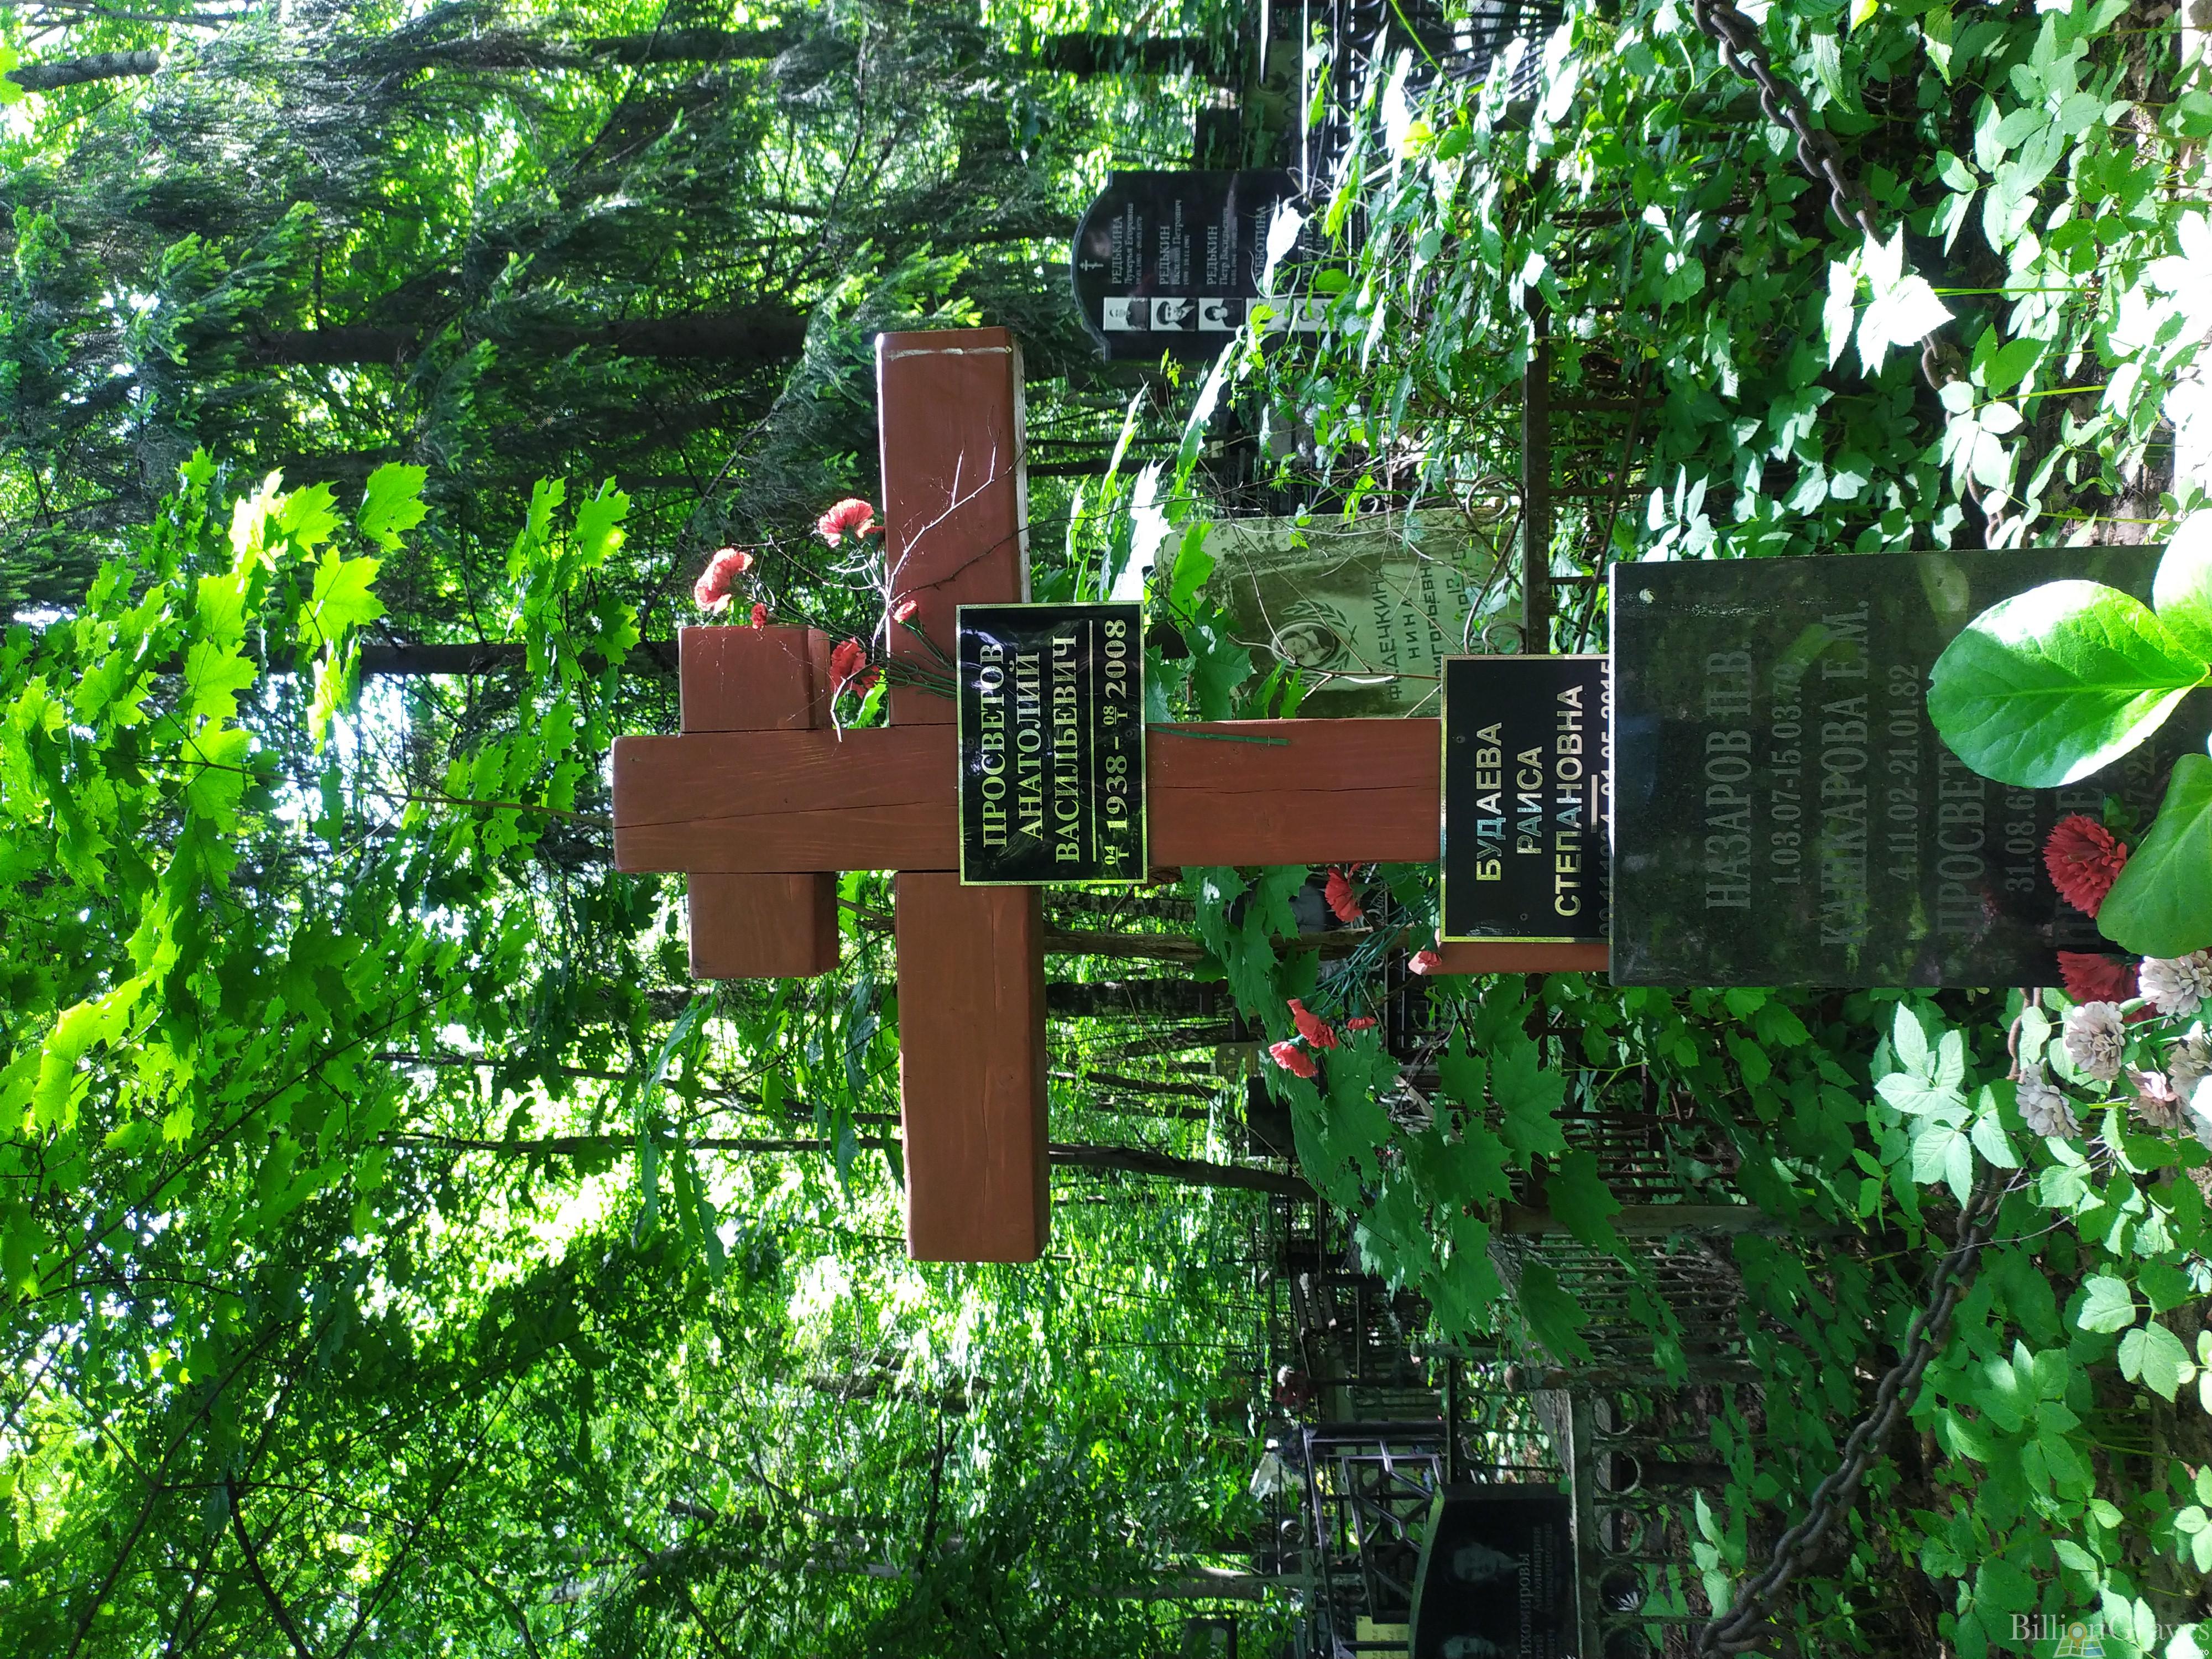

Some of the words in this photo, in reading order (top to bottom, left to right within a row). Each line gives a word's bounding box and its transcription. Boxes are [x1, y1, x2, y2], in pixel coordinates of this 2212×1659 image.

[1112, 216, 1123, 284] РЕДЬКИНА
[1159, 225, 1170, 285] РЕДЬКИН
[1172, 199, 1184, 244] Петрович
[1207, 225, 1218, 285] РЕДЬКИН
[1219, 262, 1230, 285] Петр
[1254, 205, 1266, 278] УББОТИНА
[1104, 619, 1127, 698] 2008
[1401, 597, 1421, 660] НИНА
[1419, 563, 1444, 694] ИГОРЬЕВН
[1820, 601, 1869, 680] Е.М.
[979, 644, 1008, 848] ПРОСВЕТОВ
[1009, 652, 1044, 841] АНАТОЛИЙ
[1052, 634, 1080, 863] ВАСИЛЬЕВИЧ
[1105, 755, 1128, 832] 1938
[1516, 746, 1543, 854] РАИСА
[1887, 664, 1920, 881] 4.11.02-21.01.82
[1475, 722, 1506, 881] БУДАЕВА
[1554, 685, 1583, 917] СТЕПАНОВНА
[1704, 730, 1752, 910] НАЗАРОВ
[1937, 739, 1986, 935] ПРОСВЕТ
[2004, 784, 2036, 893] 31.08.6
